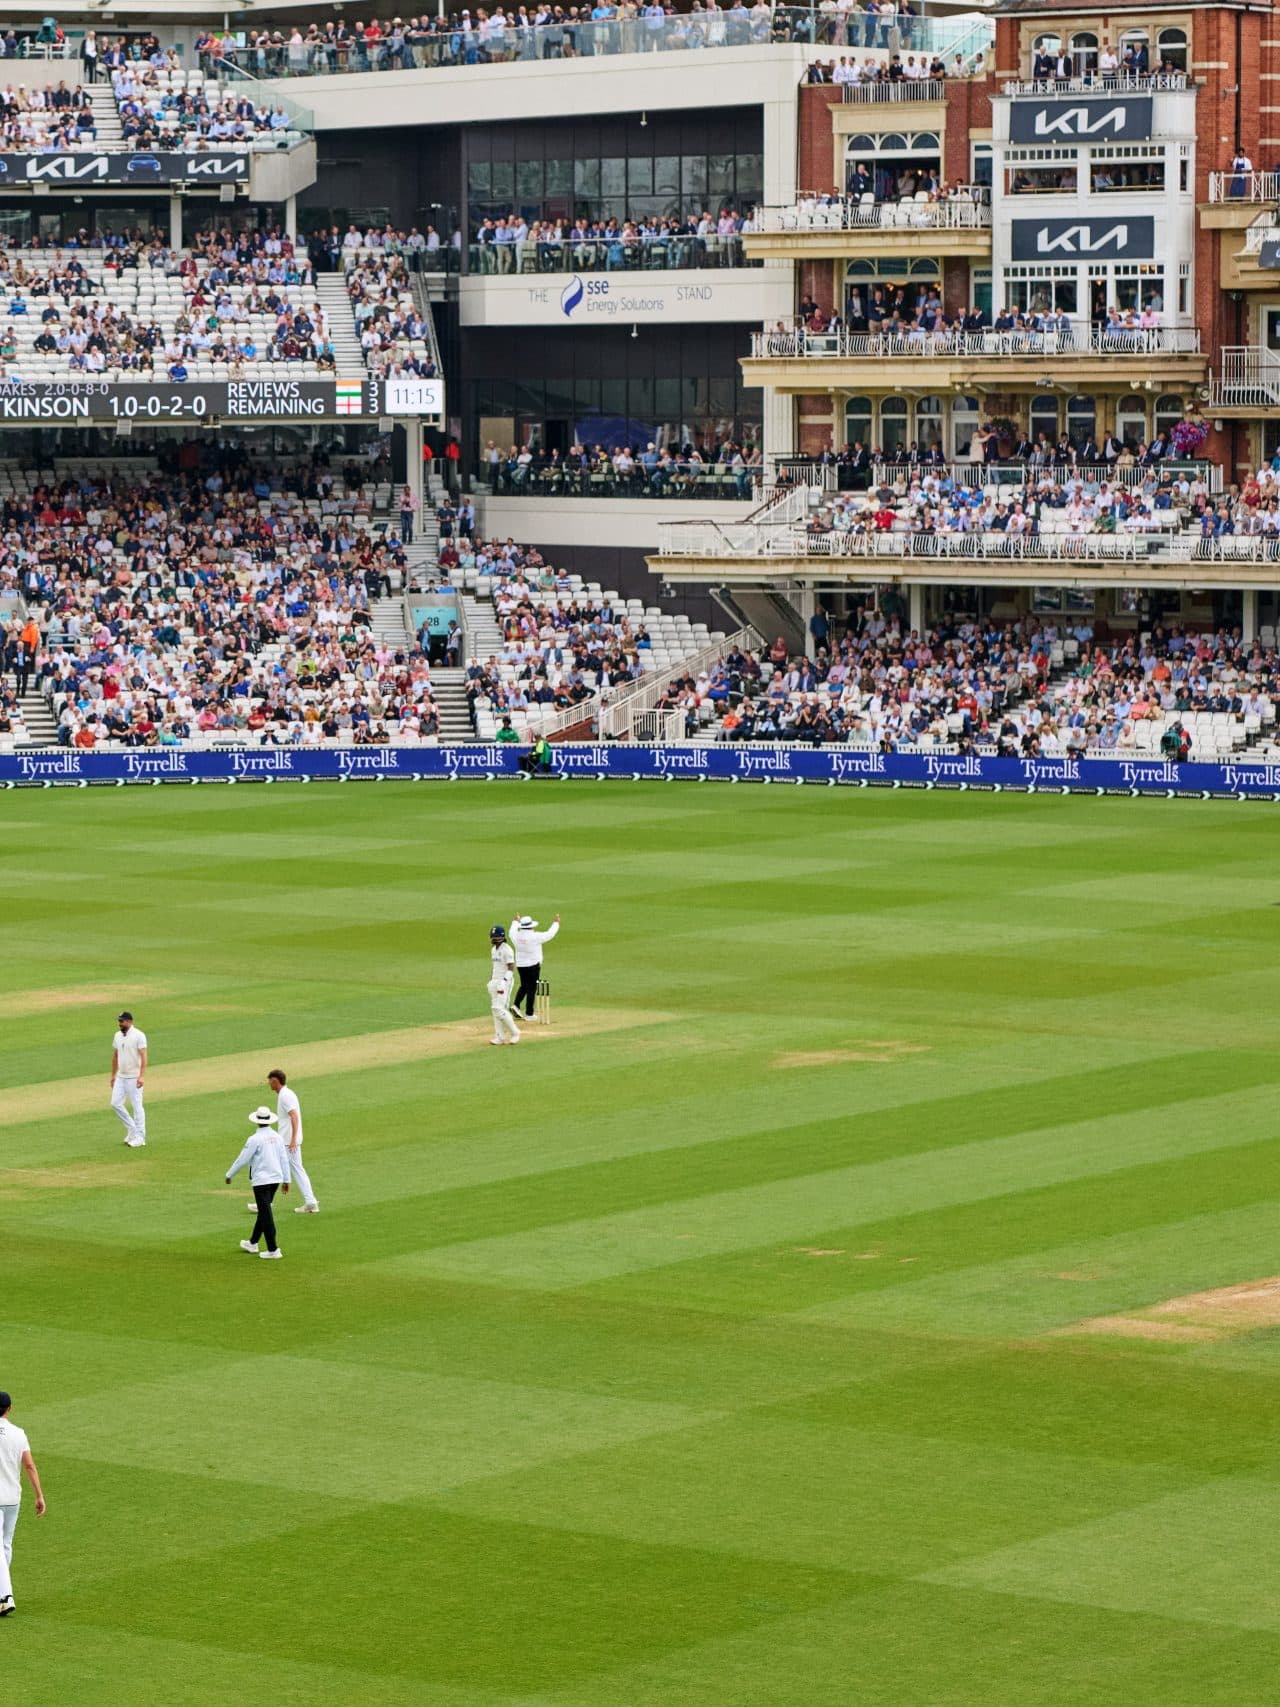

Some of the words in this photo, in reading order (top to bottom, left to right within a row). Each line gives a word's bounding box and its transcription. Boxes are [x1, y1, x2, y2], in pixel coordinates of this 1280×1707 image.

[1035, 107, 1126, 135] KIA
[26, 157, 108, 178] KIA
[188, 158, 245, 174] KIA
[1037, 225, 1128, 253] KIA
[587, 279, 609, 295] sse
[528, 289, 549, 303] THE
[587, 299, 618, 314] Energy
[621, 297, 664, 311] Solutions
[677, 286, 713, 301] STAND
[44, 384, 109, 396] 2.0-0-8-0
[228, 382, 299, 397] REVIEWS
[368, 382, 378, 397] 3
[393, 387, 435, 405] 11:15
[109, 396, 206, 417] 1.0-0-2-0
[228, 398, 324, 414] REMAINING
[368, 398, 378, 414] 3
[17, 755, 80, 780] Tyrrells
[123, 753, 185, 779] Tyrrells
[229, 751, 291, 776] Tyrrells
[334, 750, 397, 775] Tyrrells
[440, 749, 503, 774] Tyrrells
[550, 748, 609, 773] Tyrrells
[650, 749, 708, 774] Tyrrells
[735, 751, 790, 776] Tyrrells
[828, 753, 884, 778] Tyrrells
[923, 756, 981, 781] Tyrrells
[1020, 759, 1079, 784] Tyrrells
[1119, 762, 1179, 788] Tyrrells
[1220, 765, 1280, 792] Tyrrells
